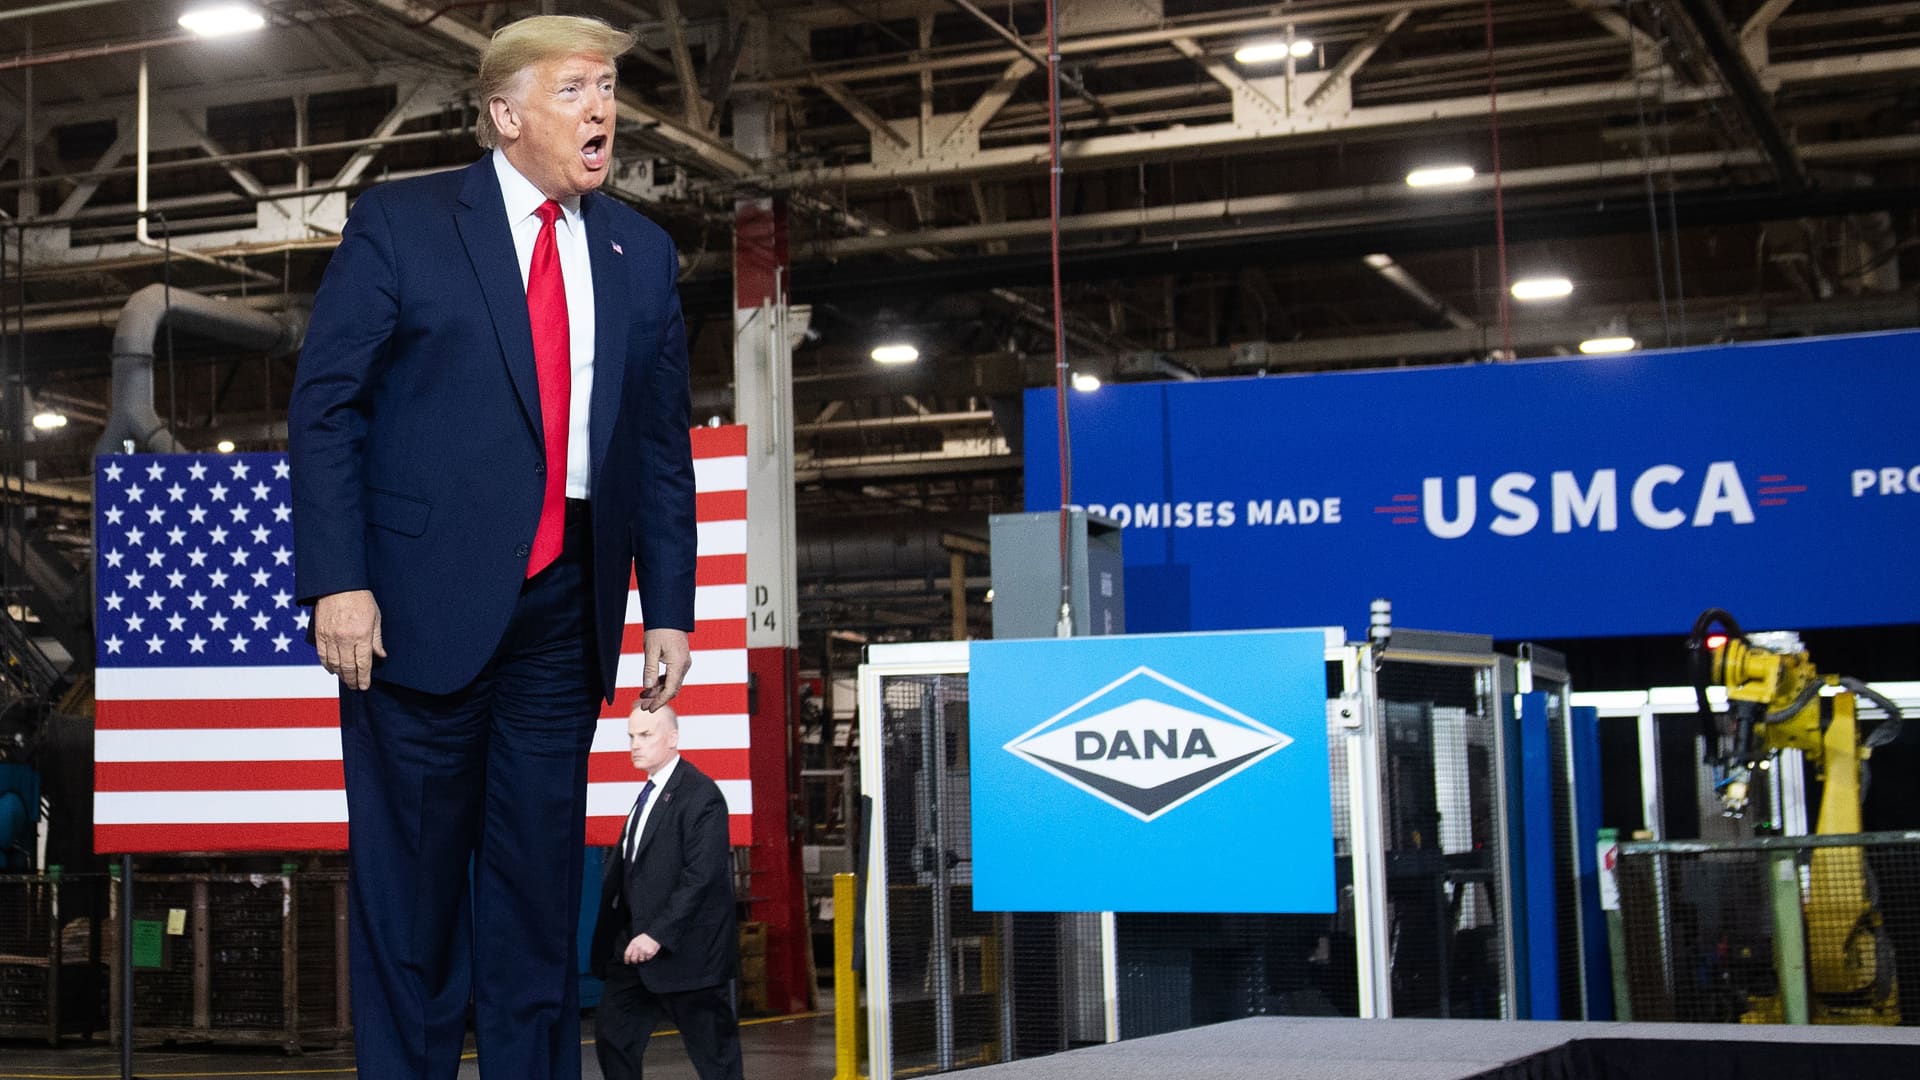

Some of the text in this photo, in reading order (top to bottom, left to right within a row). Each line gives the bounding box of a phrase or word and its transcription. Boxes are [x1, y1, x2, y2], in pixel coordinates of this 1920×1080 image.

[1068, 497, 1342, 529] OMISES MADE
[1423, 461, 1755, 539] USMCA
[755, 585, 769, 606] D
[751, 610, 776, 632] 14
[1075, 728, 1217, 761] DANA
